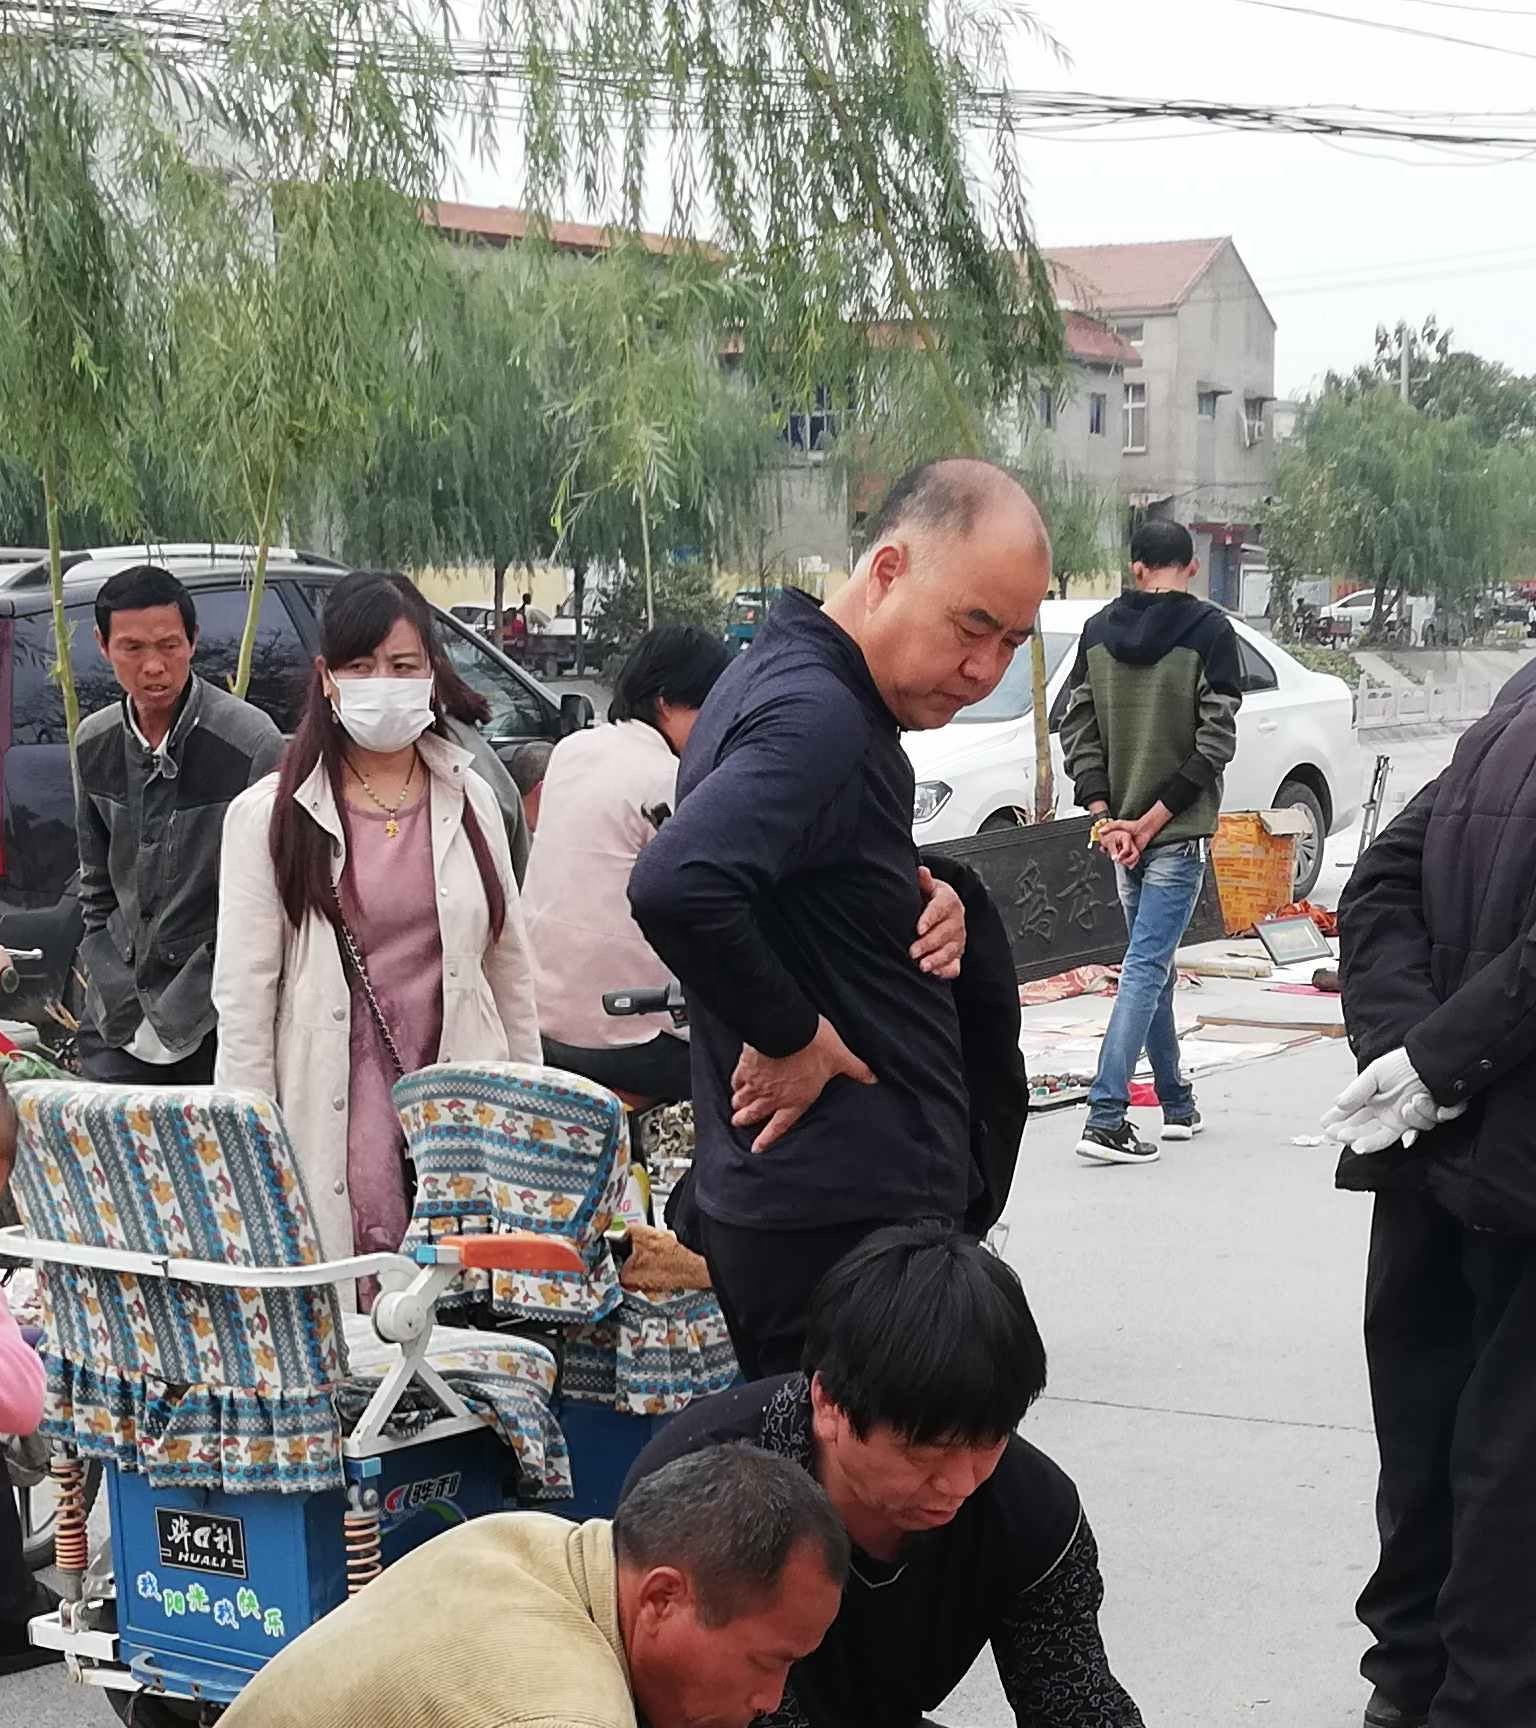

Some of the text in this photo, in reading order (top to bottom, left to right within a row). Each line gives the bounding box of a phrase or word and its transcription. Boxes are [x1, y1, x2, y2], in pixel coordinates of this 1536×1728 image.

[178, 1552, 226, 1568] HUALI
[137, 1571, 284, 1637] 我阳光我快乐
